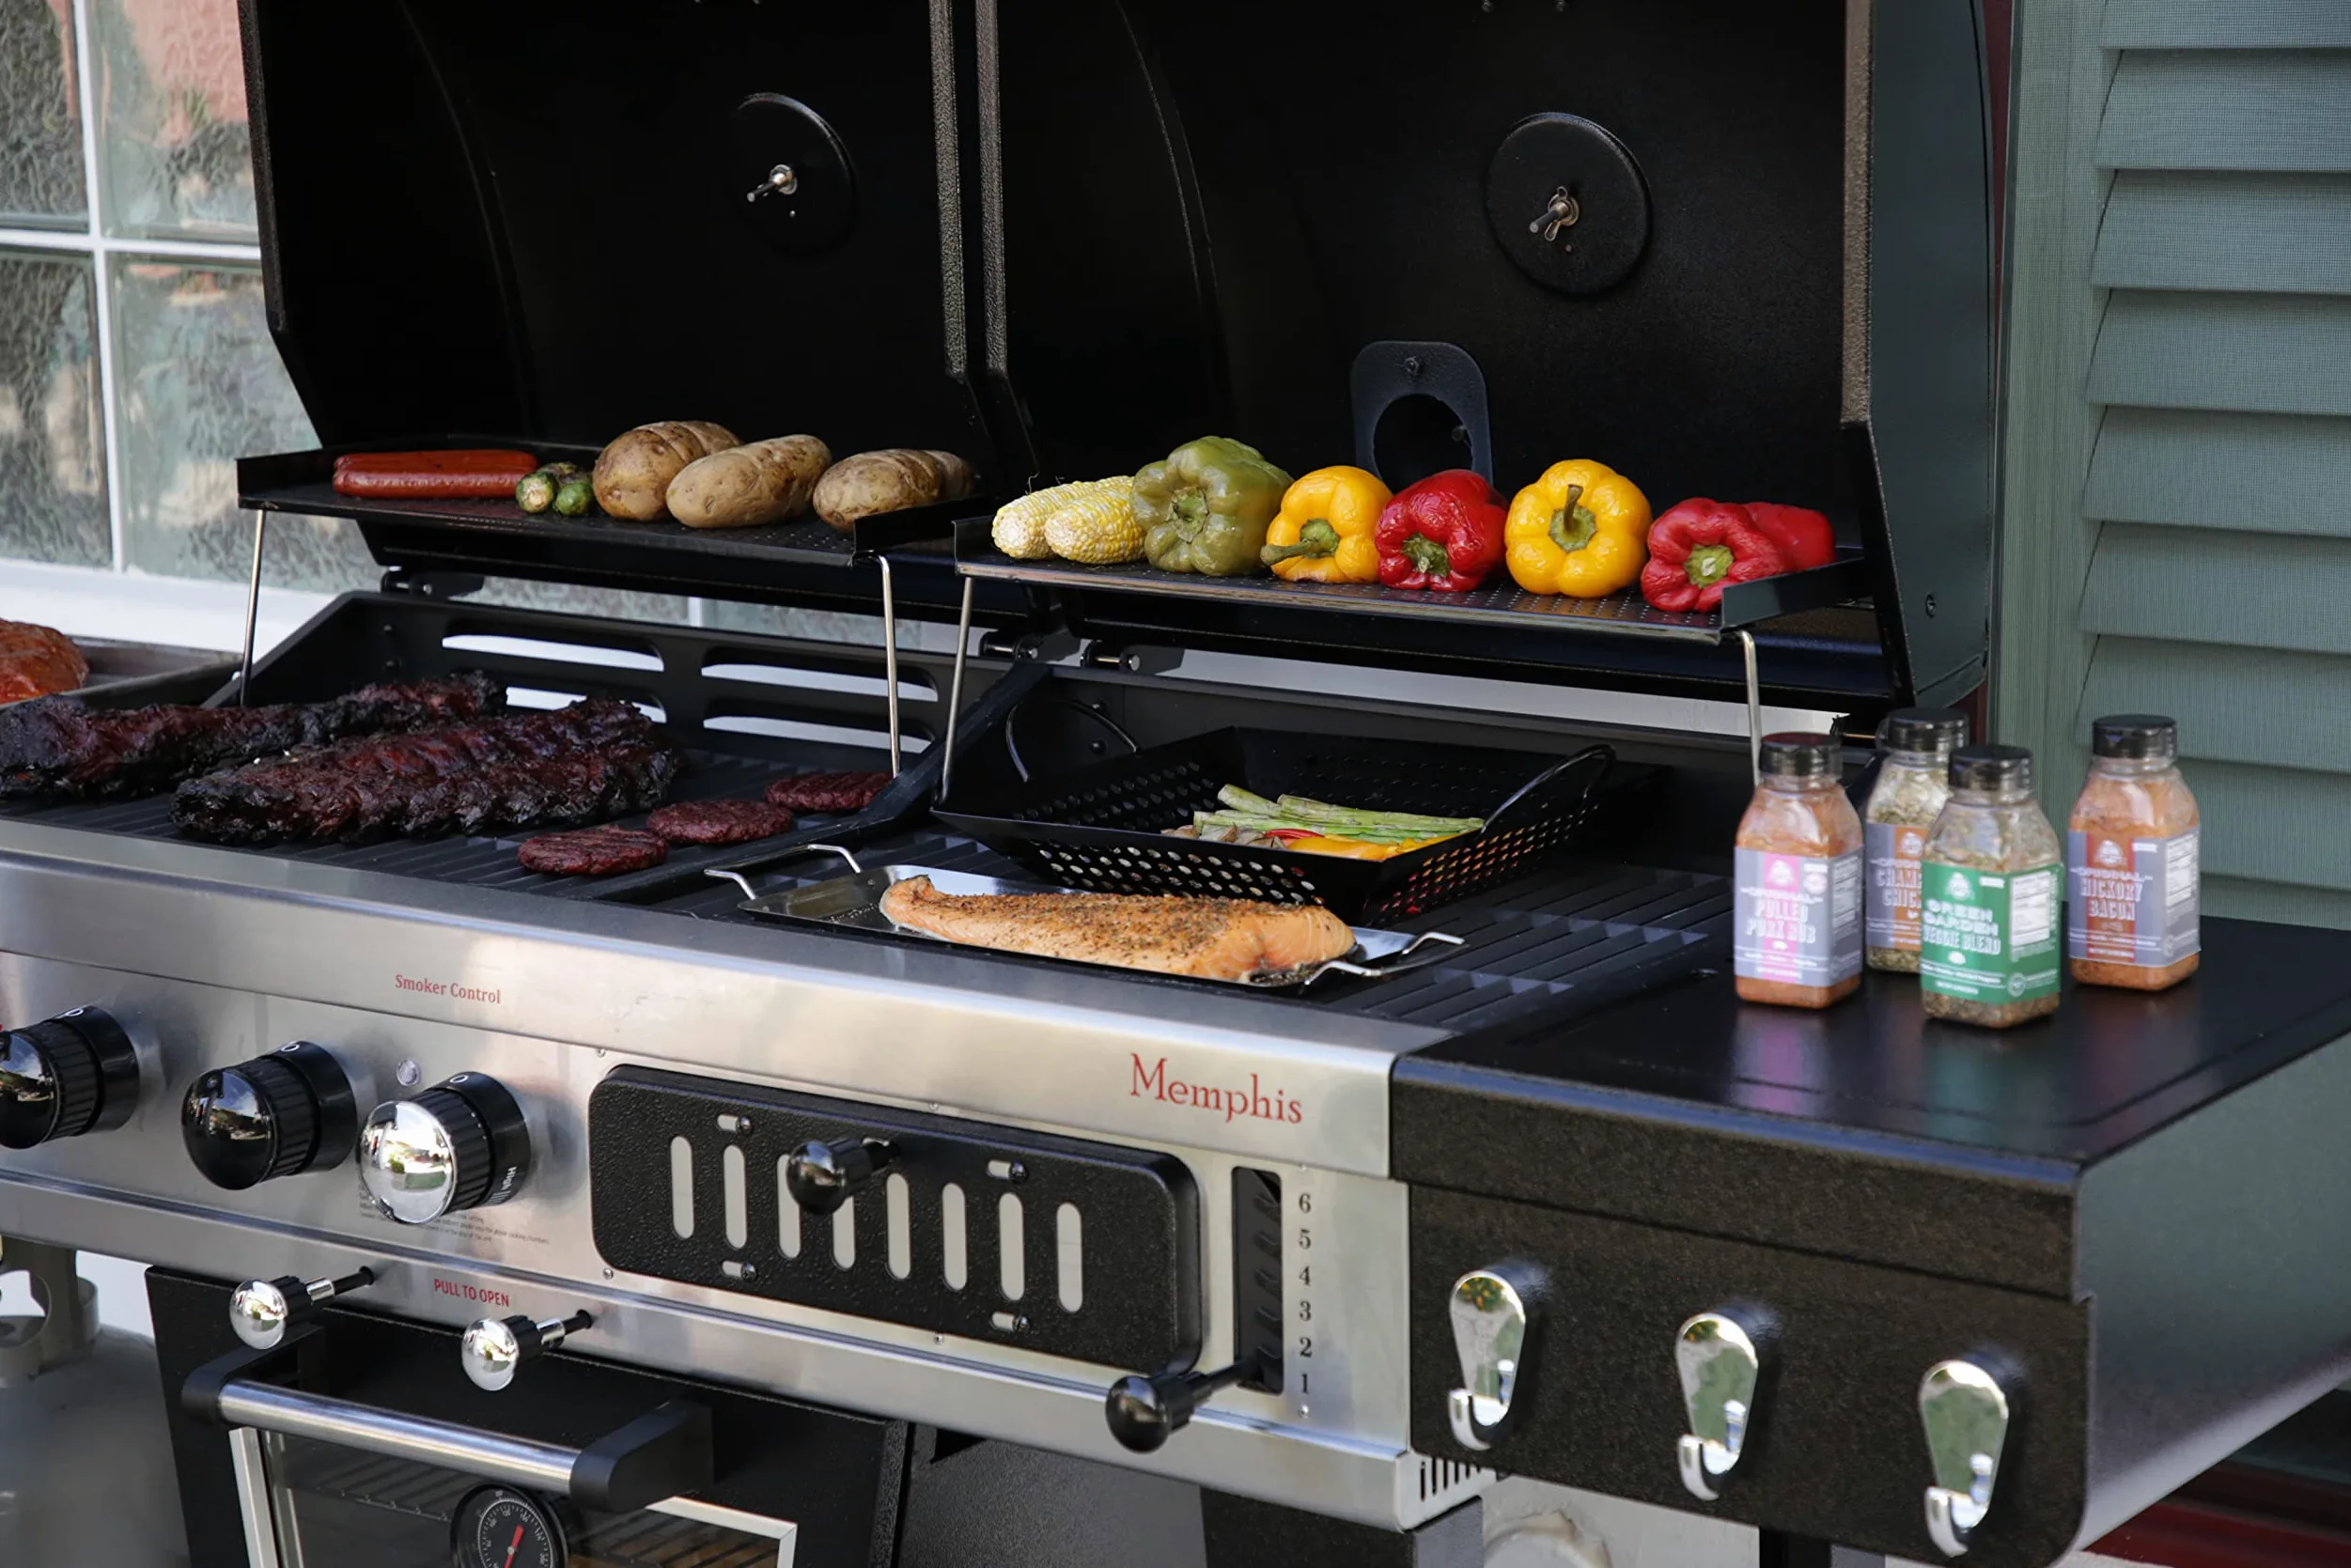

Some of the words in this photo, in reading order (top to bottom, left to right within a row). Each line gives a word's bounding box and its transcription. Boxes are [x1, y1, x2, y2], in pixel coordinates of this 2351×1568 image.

[2079, 877, 2143, 903] HICKORY
[1754, 899, 1809, 923] PULLED
[1927, 898, 1993, 923] GREEN
[2088, 899, 2136, 922] BACON
[1746, 919, 1785, 940] PORK
[1923, 911, 2000, 937] GARDEN
[1923, 924, 1961, 948] VEGGIE
[1961, 935, 2001, 955] BLEND
[395, 974, 447, 996] Smoker
[450, 983, 501, 1004] Control
[1130, 1052, 1302, 1124] Memphis
[1299, 1193, 1312, 1214] 6
[1299, 1229, 1312, 1250] 5
[1299, 1266, 1312, 1286] 4
[434, 1279, 460, 1297] PULL
[462, 1284, 477, 1301] TO
[479, 1289, 509, 1308] OPEN
[1300, 1300, 1312, 1321] 3
[1300, 1337, 1313, 1358] 2
[1300, 1373, 1310, 1394] 1
